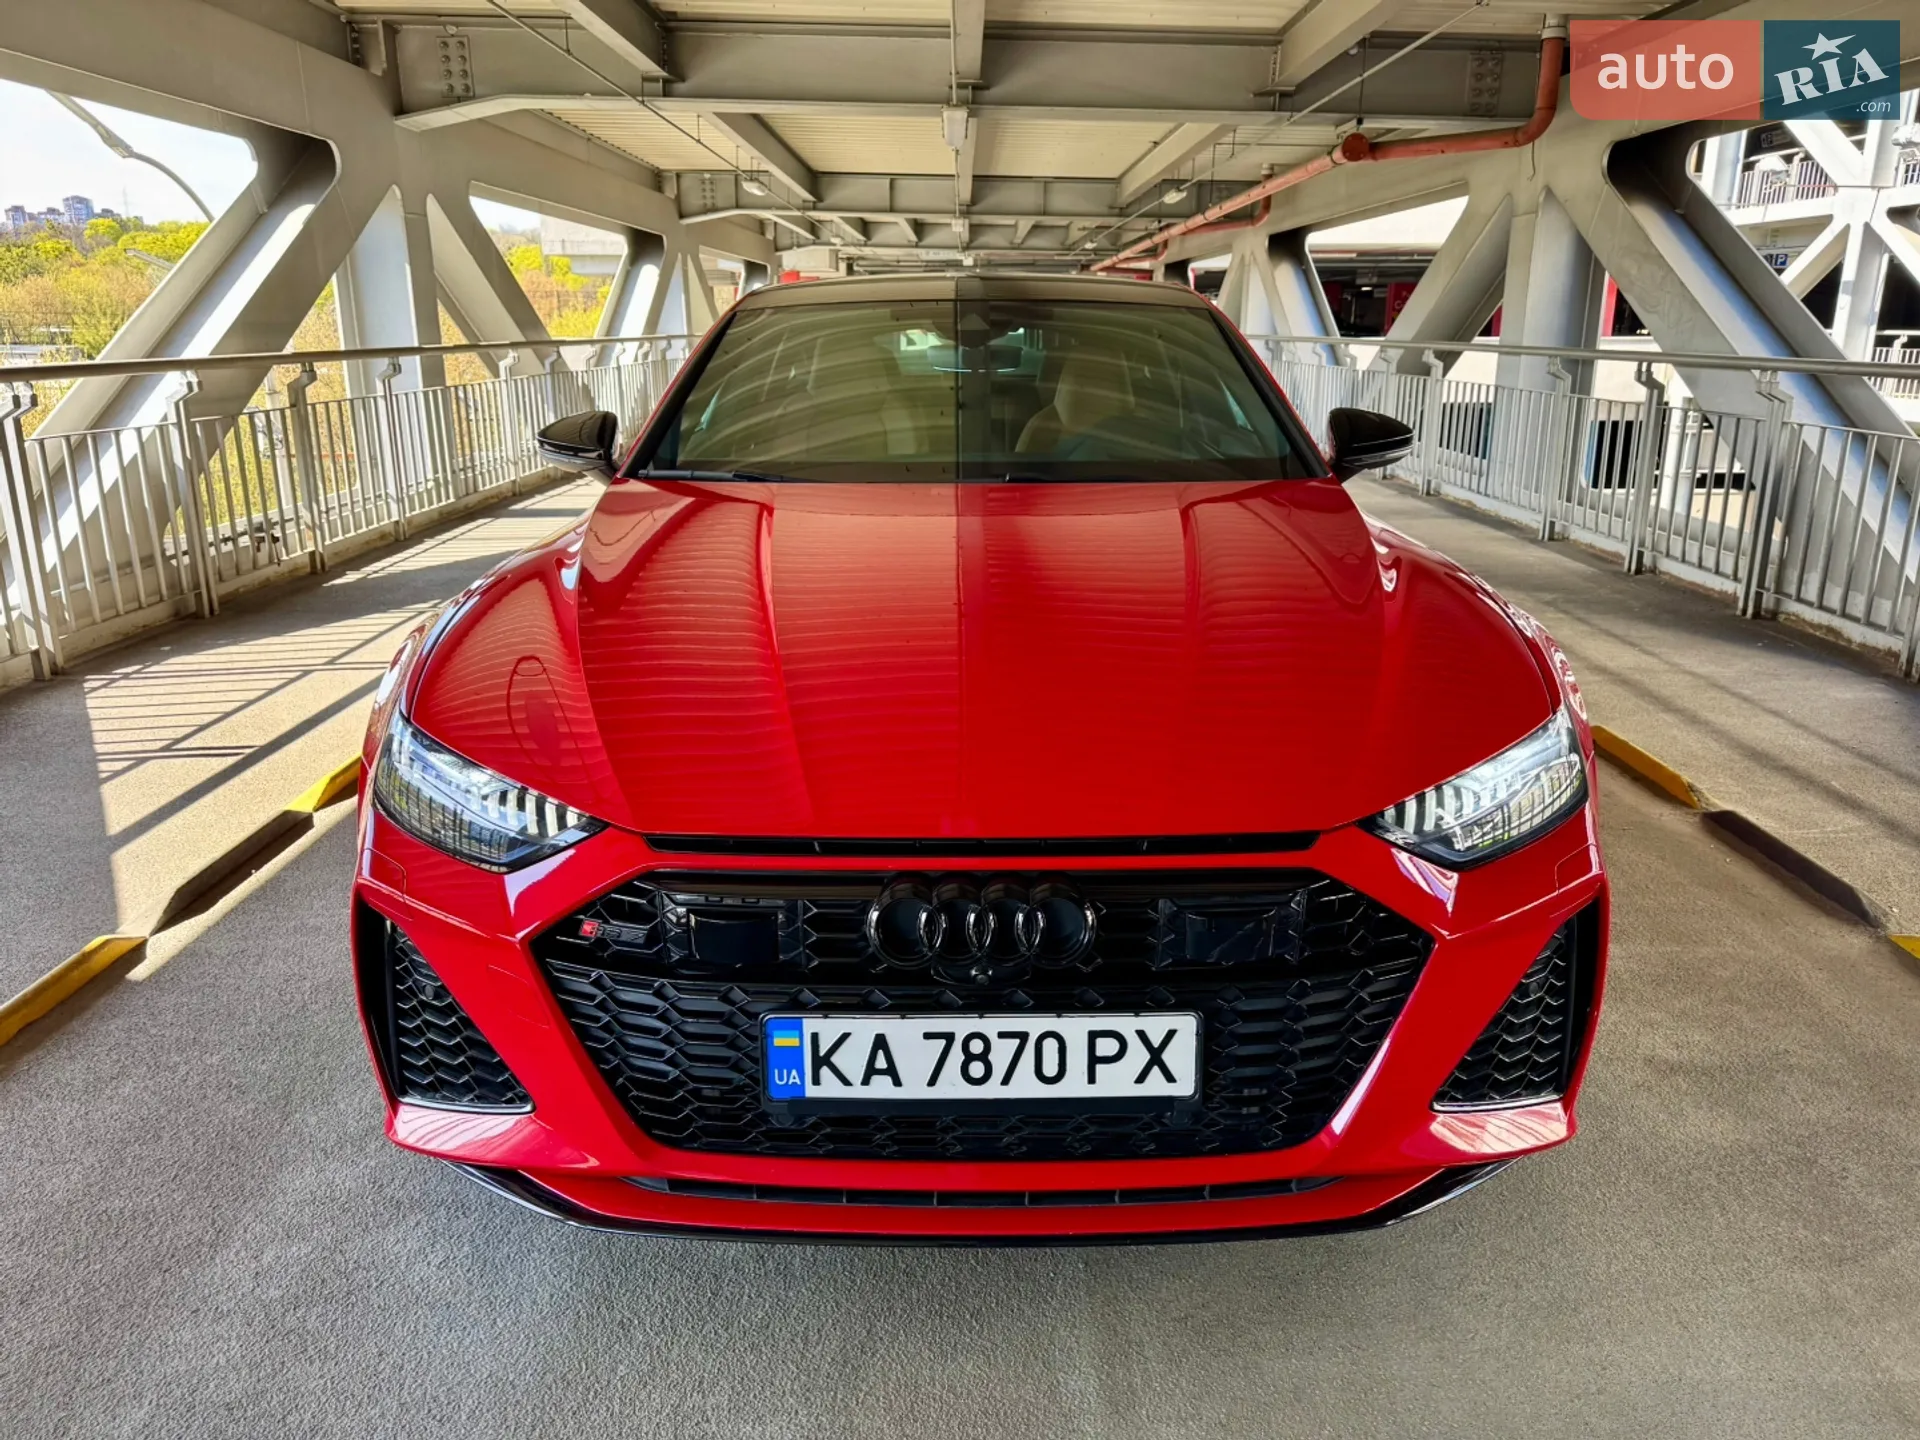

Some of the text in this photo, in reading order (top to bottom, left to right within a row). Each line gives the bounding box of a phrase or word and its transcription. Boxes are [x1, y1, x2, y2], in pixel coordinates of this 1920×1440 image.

[810, 1029, 1178, 1087] KA 7870 PX
[774, 1069, 801, 1086] UA
